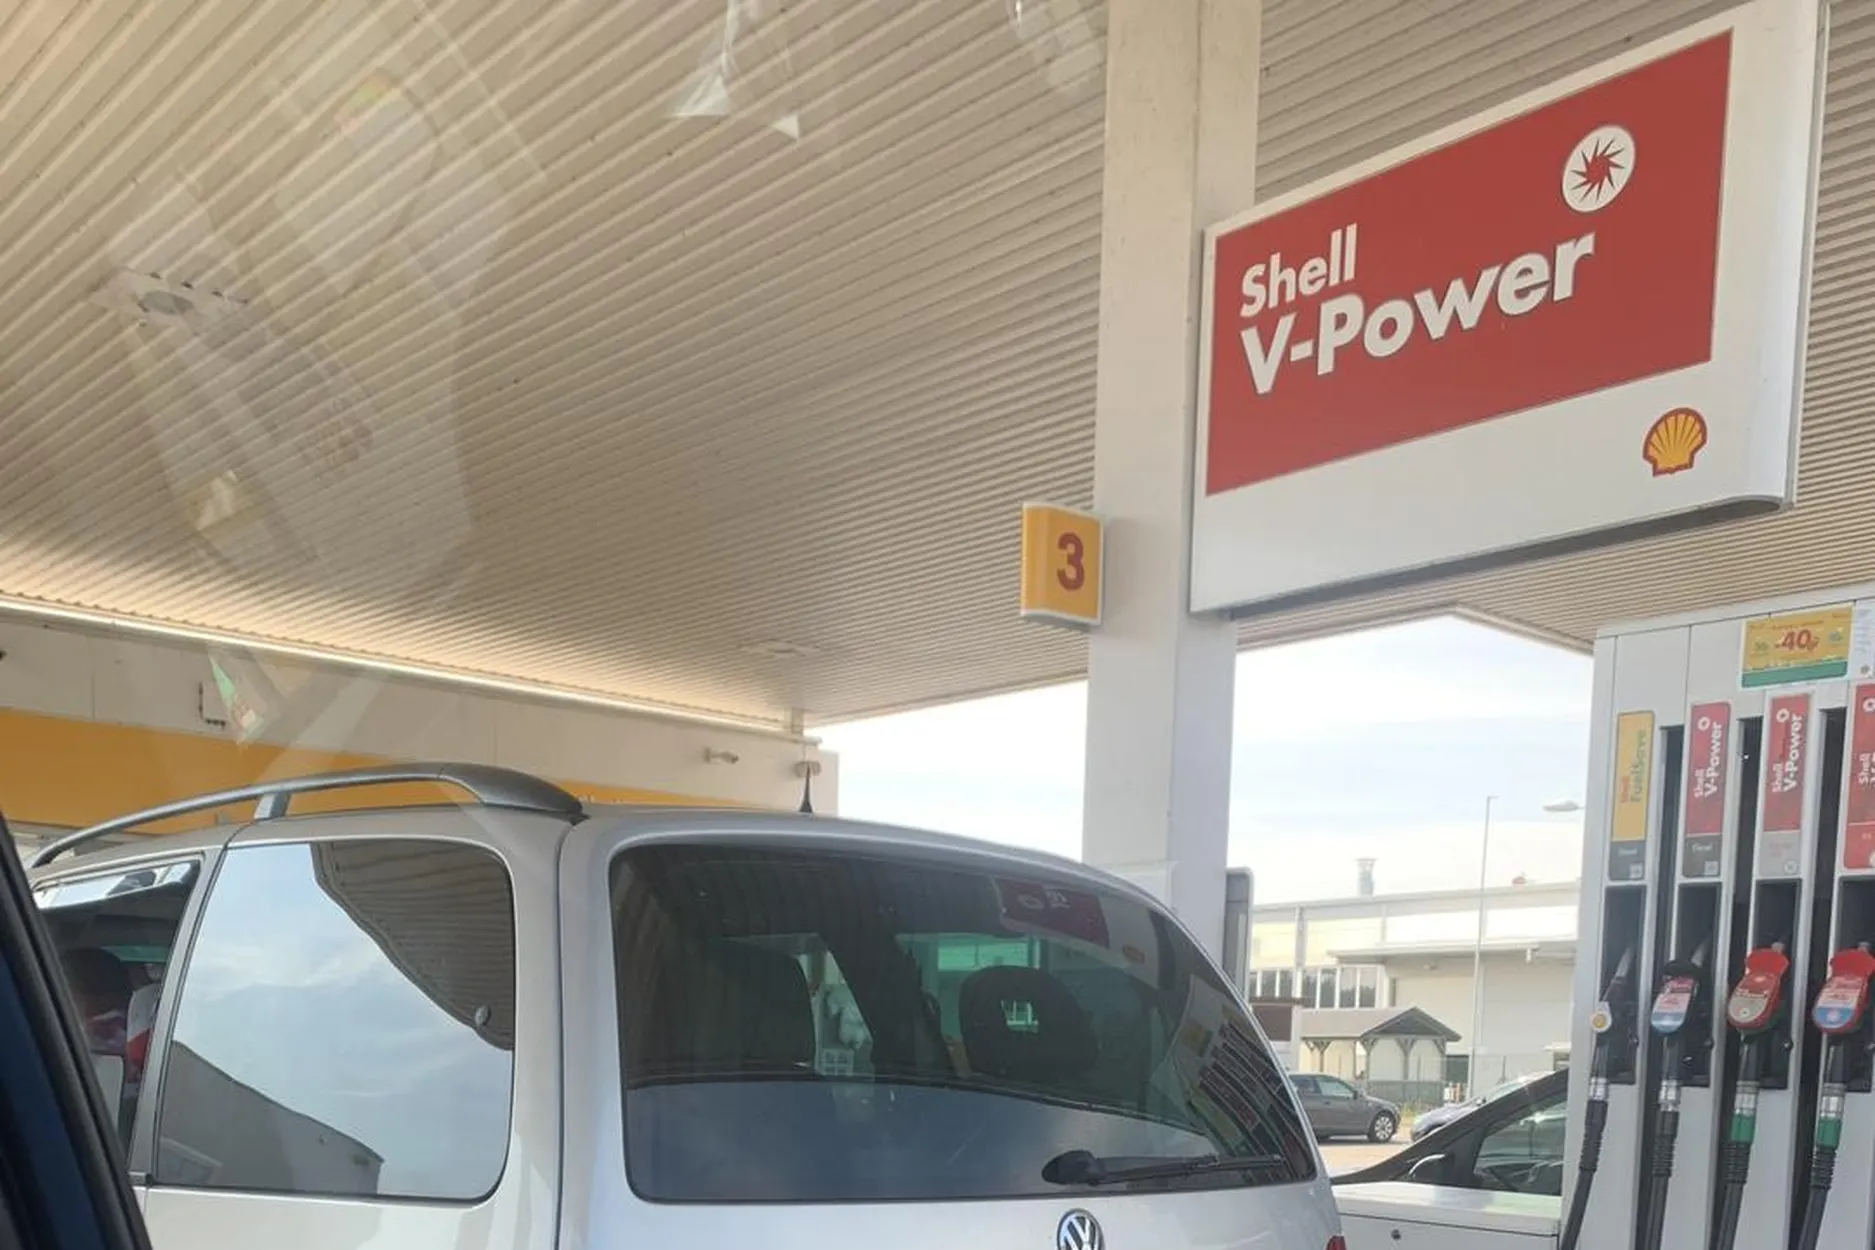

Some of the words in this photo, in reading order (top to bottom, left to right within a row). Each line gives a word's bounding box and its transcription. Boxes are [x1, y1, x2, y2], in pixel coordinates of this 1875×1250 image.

[1240, 223, 1358, 318] Shell
[1241, 232, 1596, 395] V-Power
[1057, 532, 1085, 591] 3
[1704, 721, 1723, 797] V-Power
[1783, 714, 1803, 792] V-Power
[1858, 753, 1871, 785] Shell
